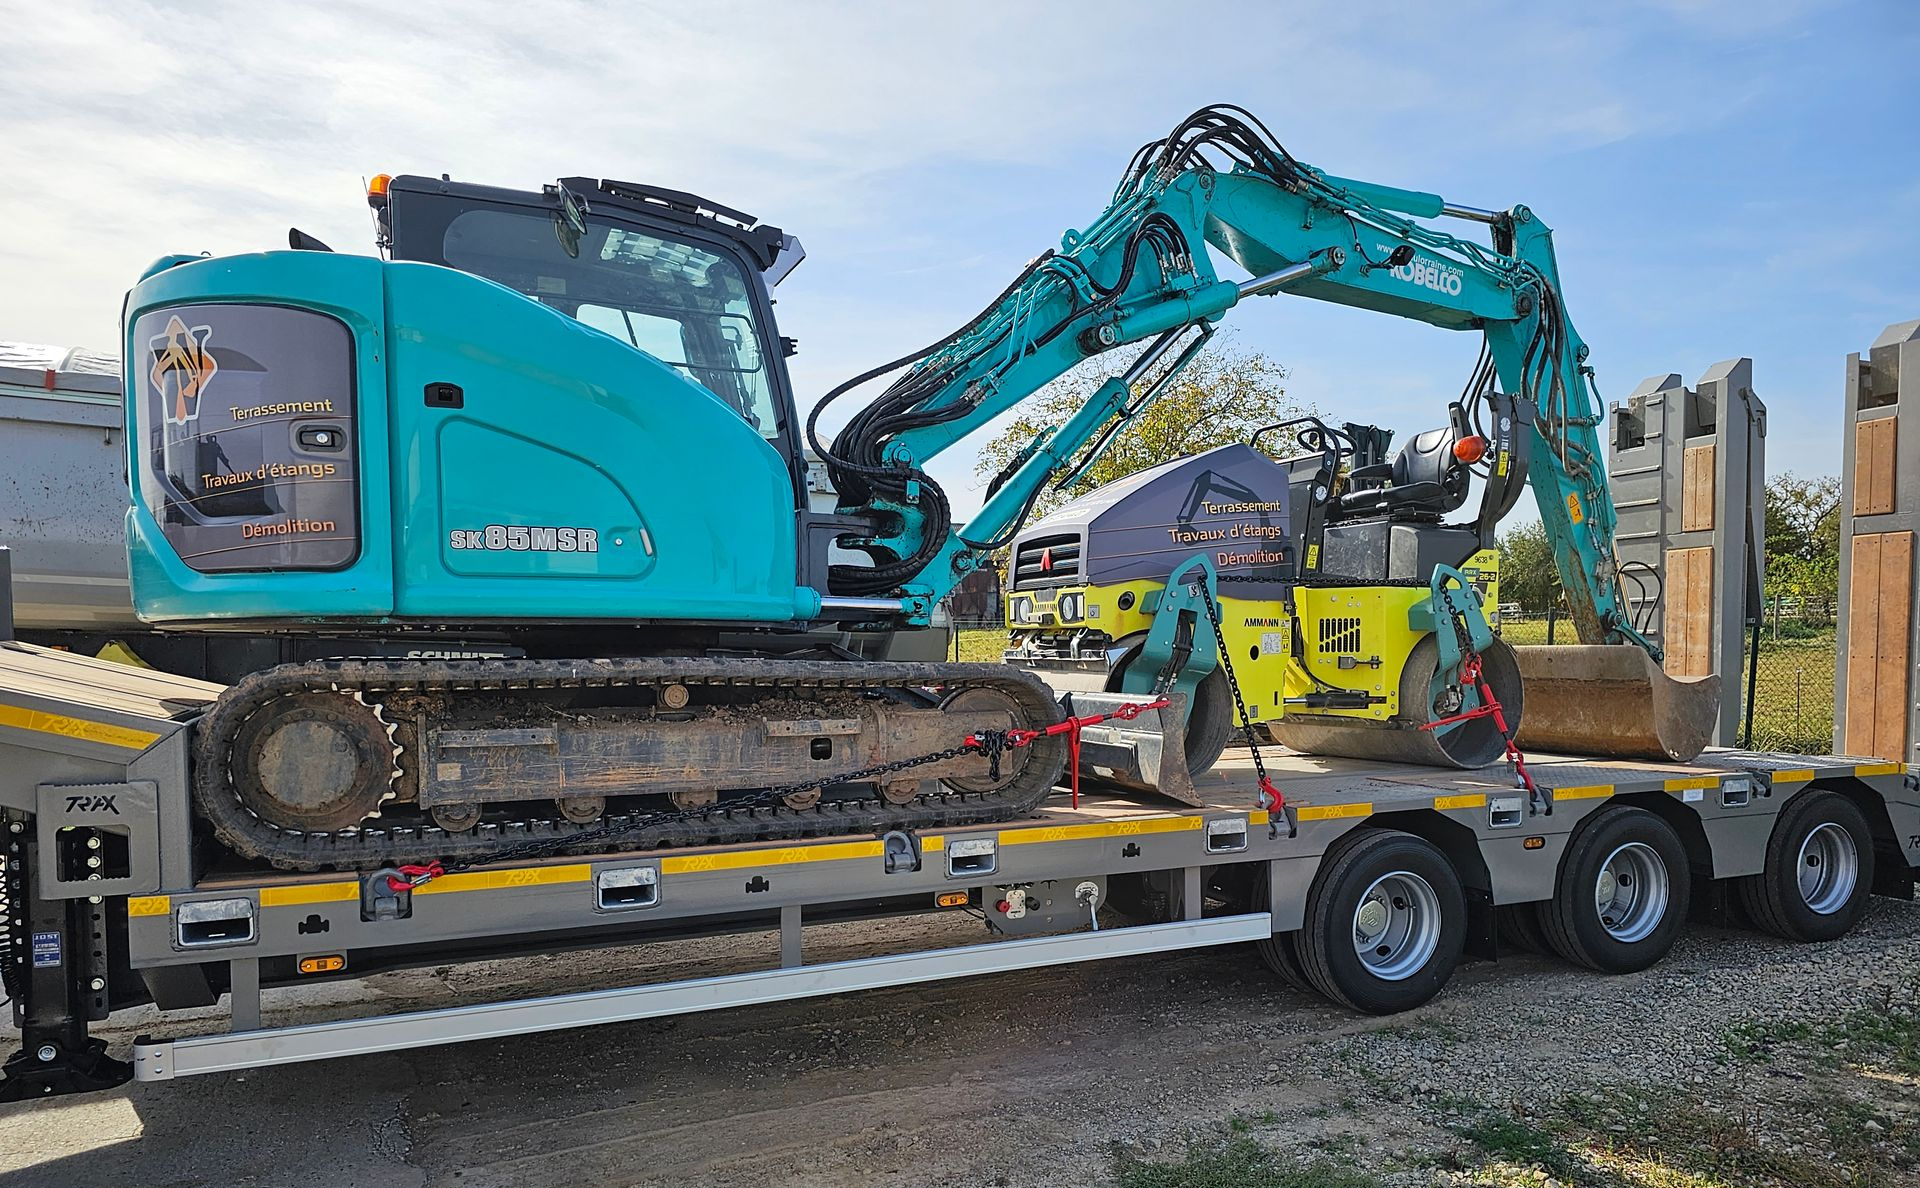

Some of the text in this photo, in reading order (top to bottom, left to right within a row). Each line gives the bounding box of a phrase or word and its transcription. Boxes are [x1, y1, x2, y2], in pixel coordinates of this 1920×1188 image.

[1390, 261, 1462, 296] KOBELCO
[229, 398, 334, 421] Terrassement
[202, 462, 336, 489] Travaux d'étangs
[1201, 500, 1281, 515] Terrassement
[242, 518, 336, 539] Démolition
[1168, 523, 1281, 543] Travaux d'étangs
[1217, 549, 1284, 567] Démolition
[1244, 617, 1279, 628] AMMANN
